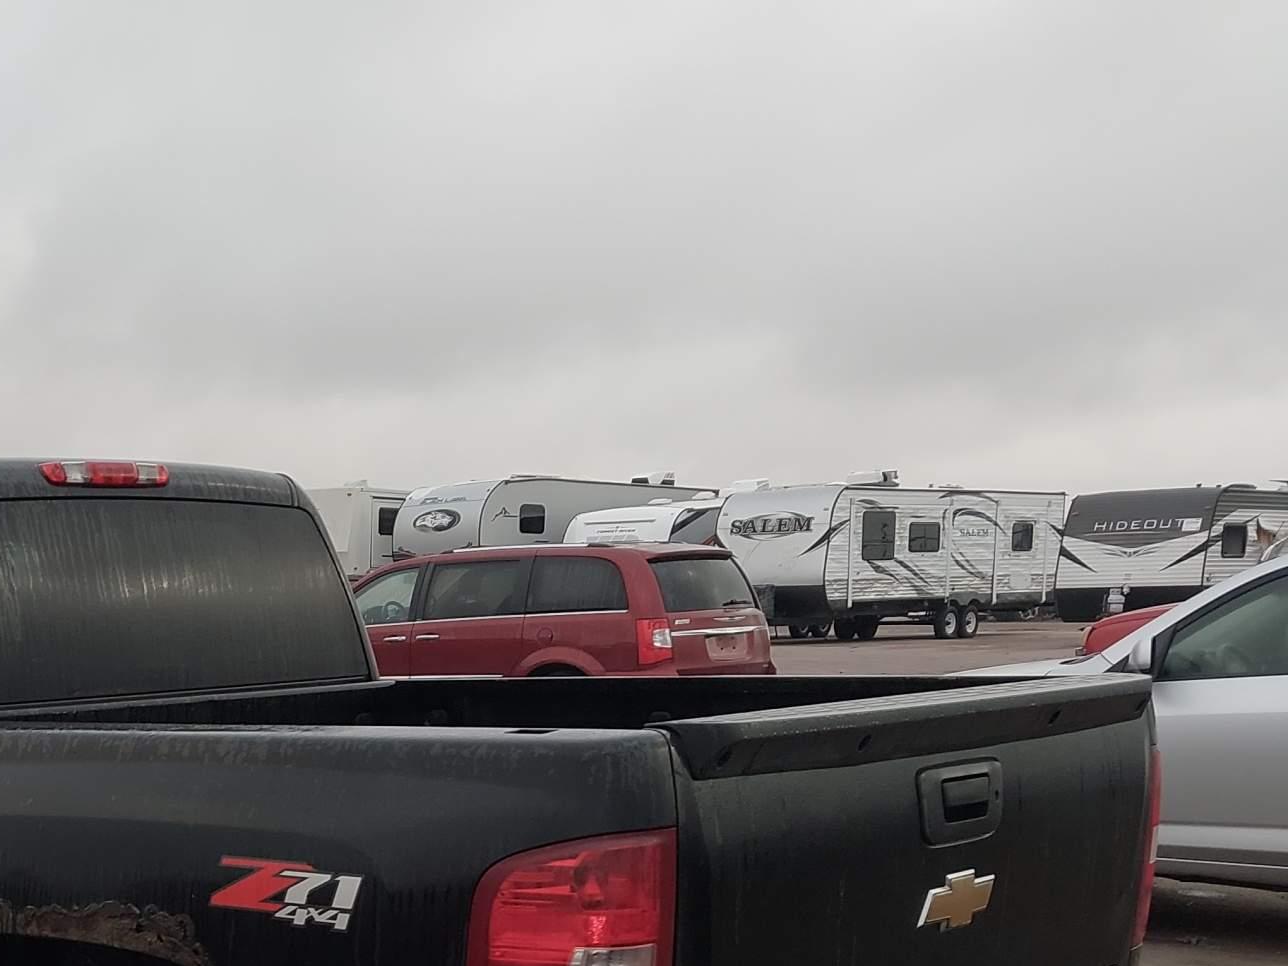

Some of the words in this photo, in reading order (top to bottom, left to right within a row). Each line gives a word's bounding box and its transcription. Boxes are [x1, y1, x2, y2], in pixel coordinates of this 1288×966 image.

[730, 517, 816, 536] SALEM
[1094, 518, 1185, 532] HIDEOUT
[209, 855, 363, 913] Z71
